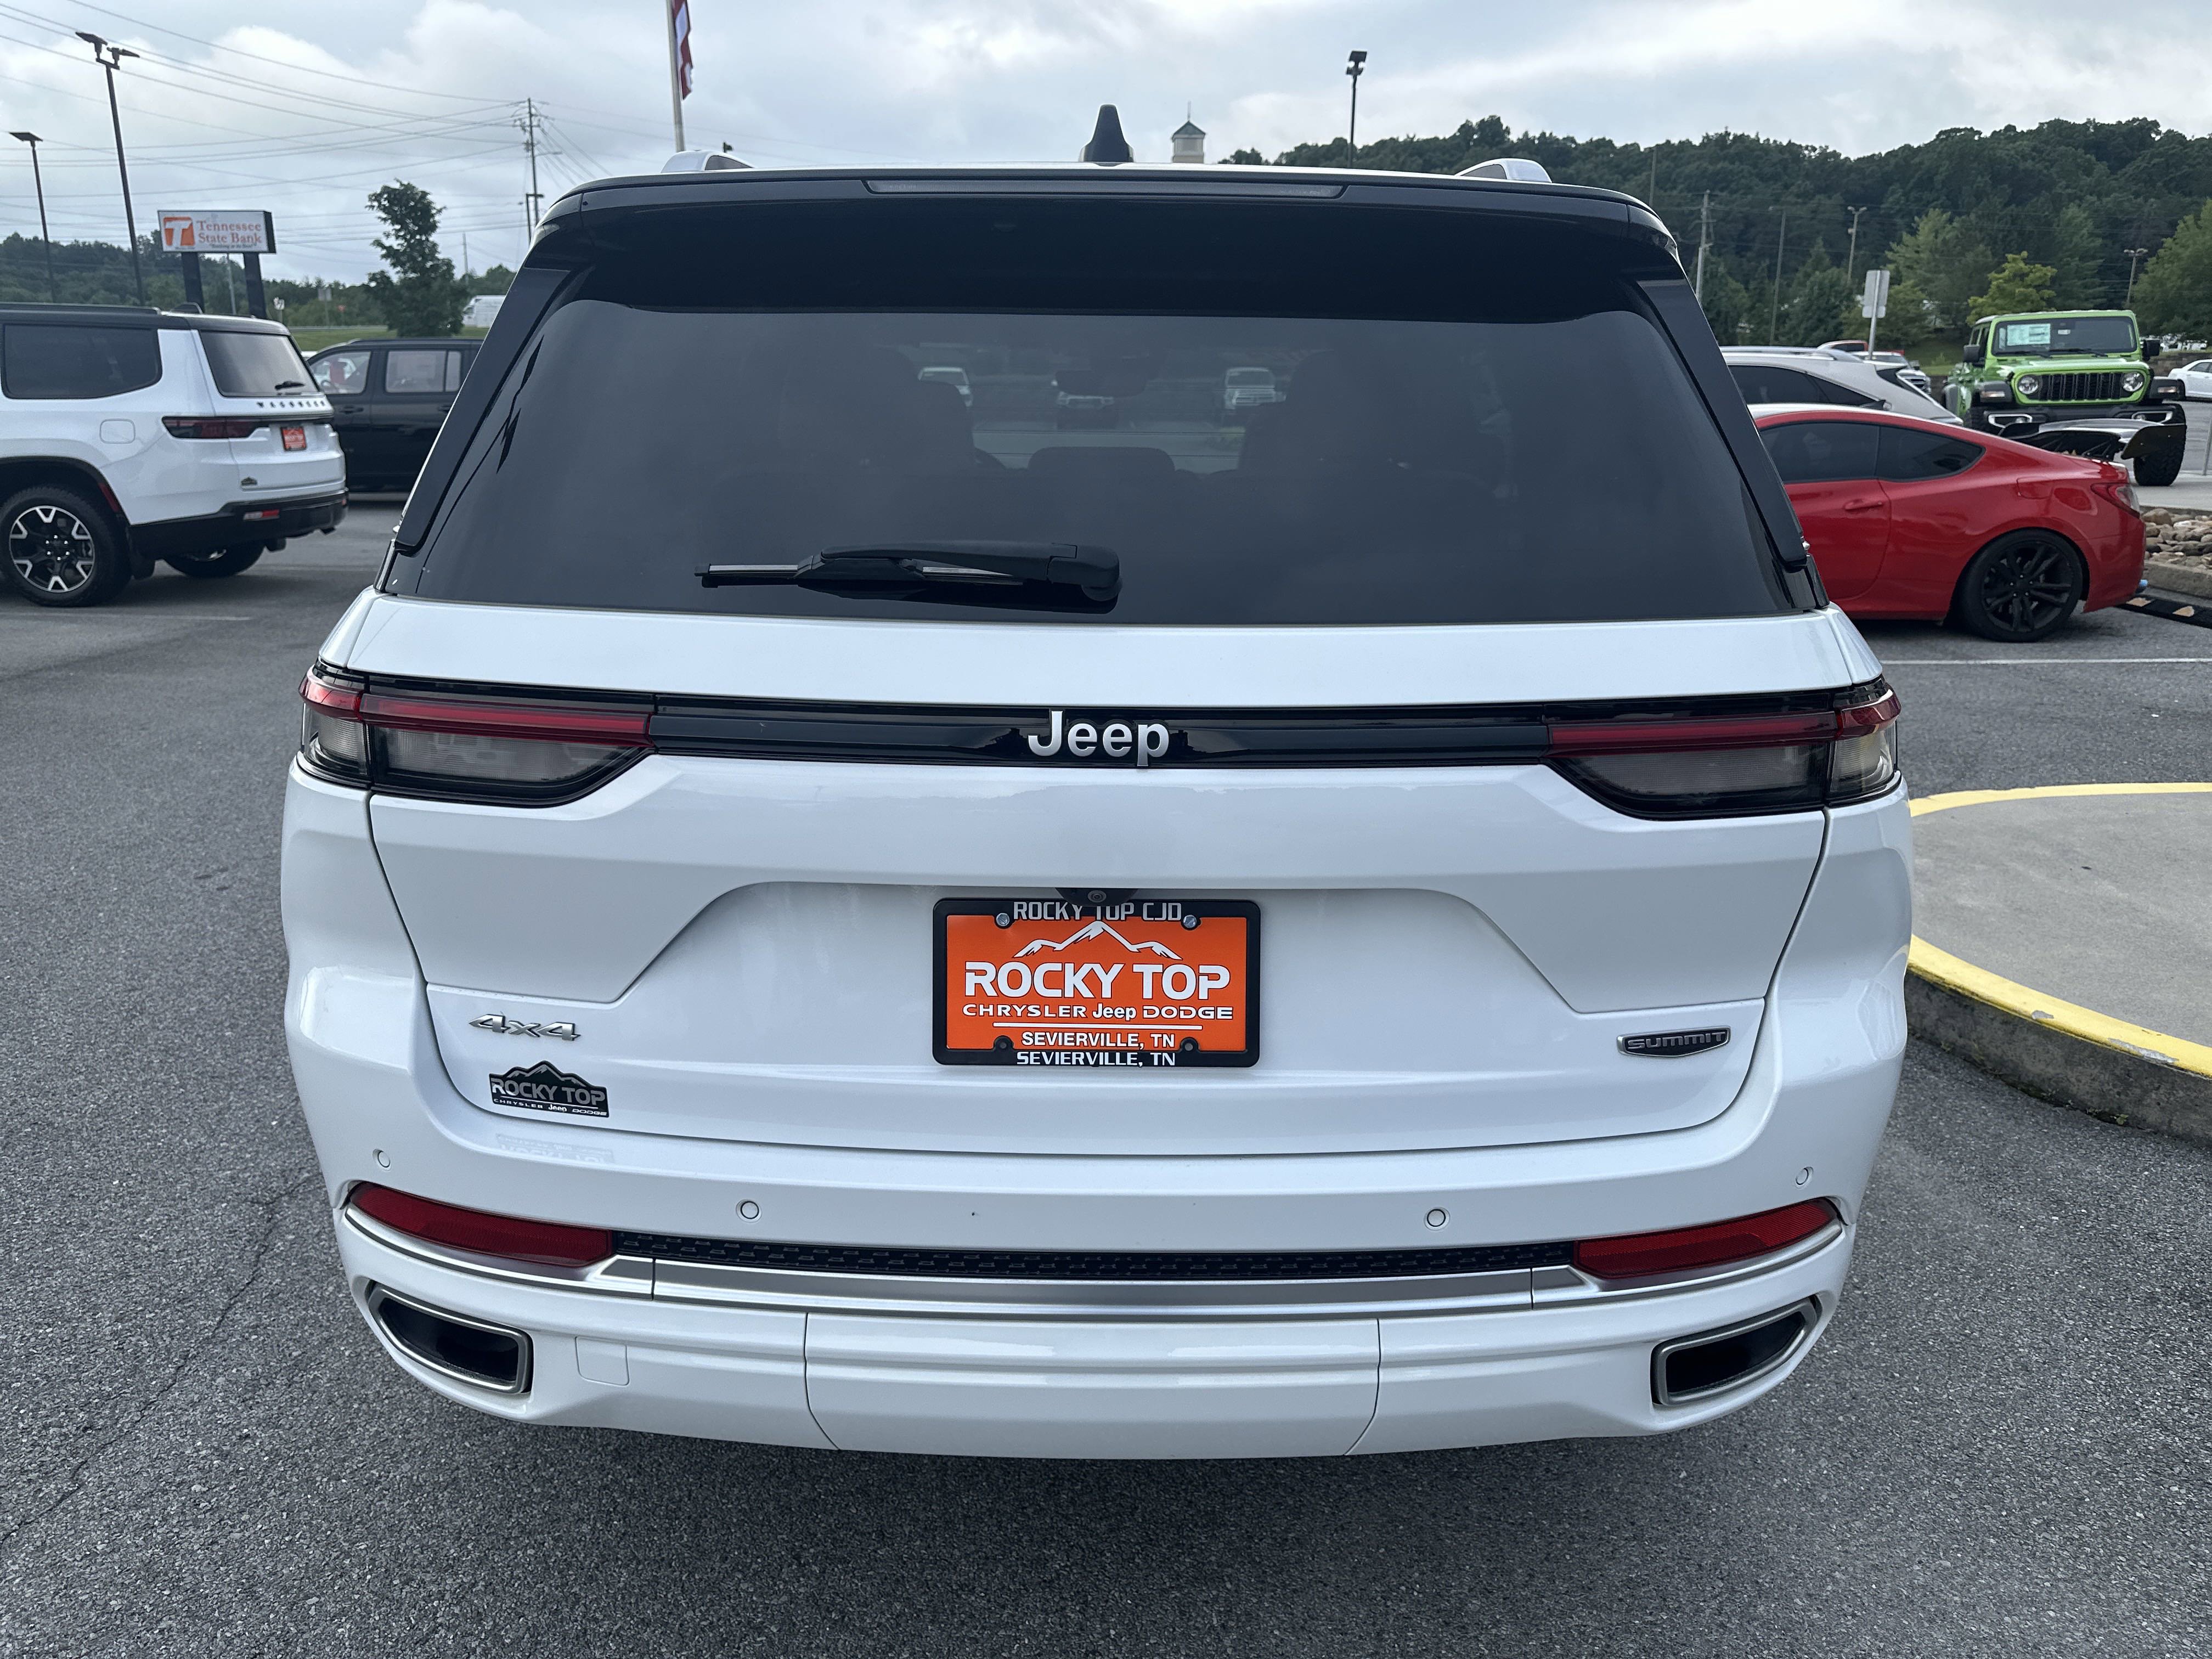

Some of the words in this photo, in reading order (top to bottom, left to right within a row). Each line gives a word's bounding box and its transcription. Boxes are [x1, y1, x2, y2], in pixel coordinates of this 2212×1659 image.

[196, 220, 261, 231] Tennessee
[198, 233, 228, 243] State
[231, 233, 262, 243] Bank
[1028, 710, 1170, 766] Jeep
[1013, 901, 1083, 920] ROCKY
[1143, 902, 1182, 921] CJD
[964, 961, 1126, 998] ROCKY
[1132, 963, 1231, 1000] TOP
[962, 1003, 1087, 1018] CHRYSLER
[1092, 1002, 1137, 1020] Jeep
[1142, 1005, 1233, 1020] DODGE
[469, 1013, 582, 1041] 4x4
[1021, 1031, 1145, 1049] SEVIERVILLE,
[1150, 1033, 1175, 1048] TN
[1628, 1031, 1726, 1049] SUMMIT
[1016, 1051, 1143, 1067] SEVIERVILLE,
[1150, 1052, 1176, 1066] TN
[490, 1077, 558, 1101] ROCKY
[561, 1086, 606, 1105] TOP
[493, 1098, 543, 1109] CHRYSLER
[548, 1104, 567, 1113] Jeep
[572, 1108, 607, 1116] DODGE
